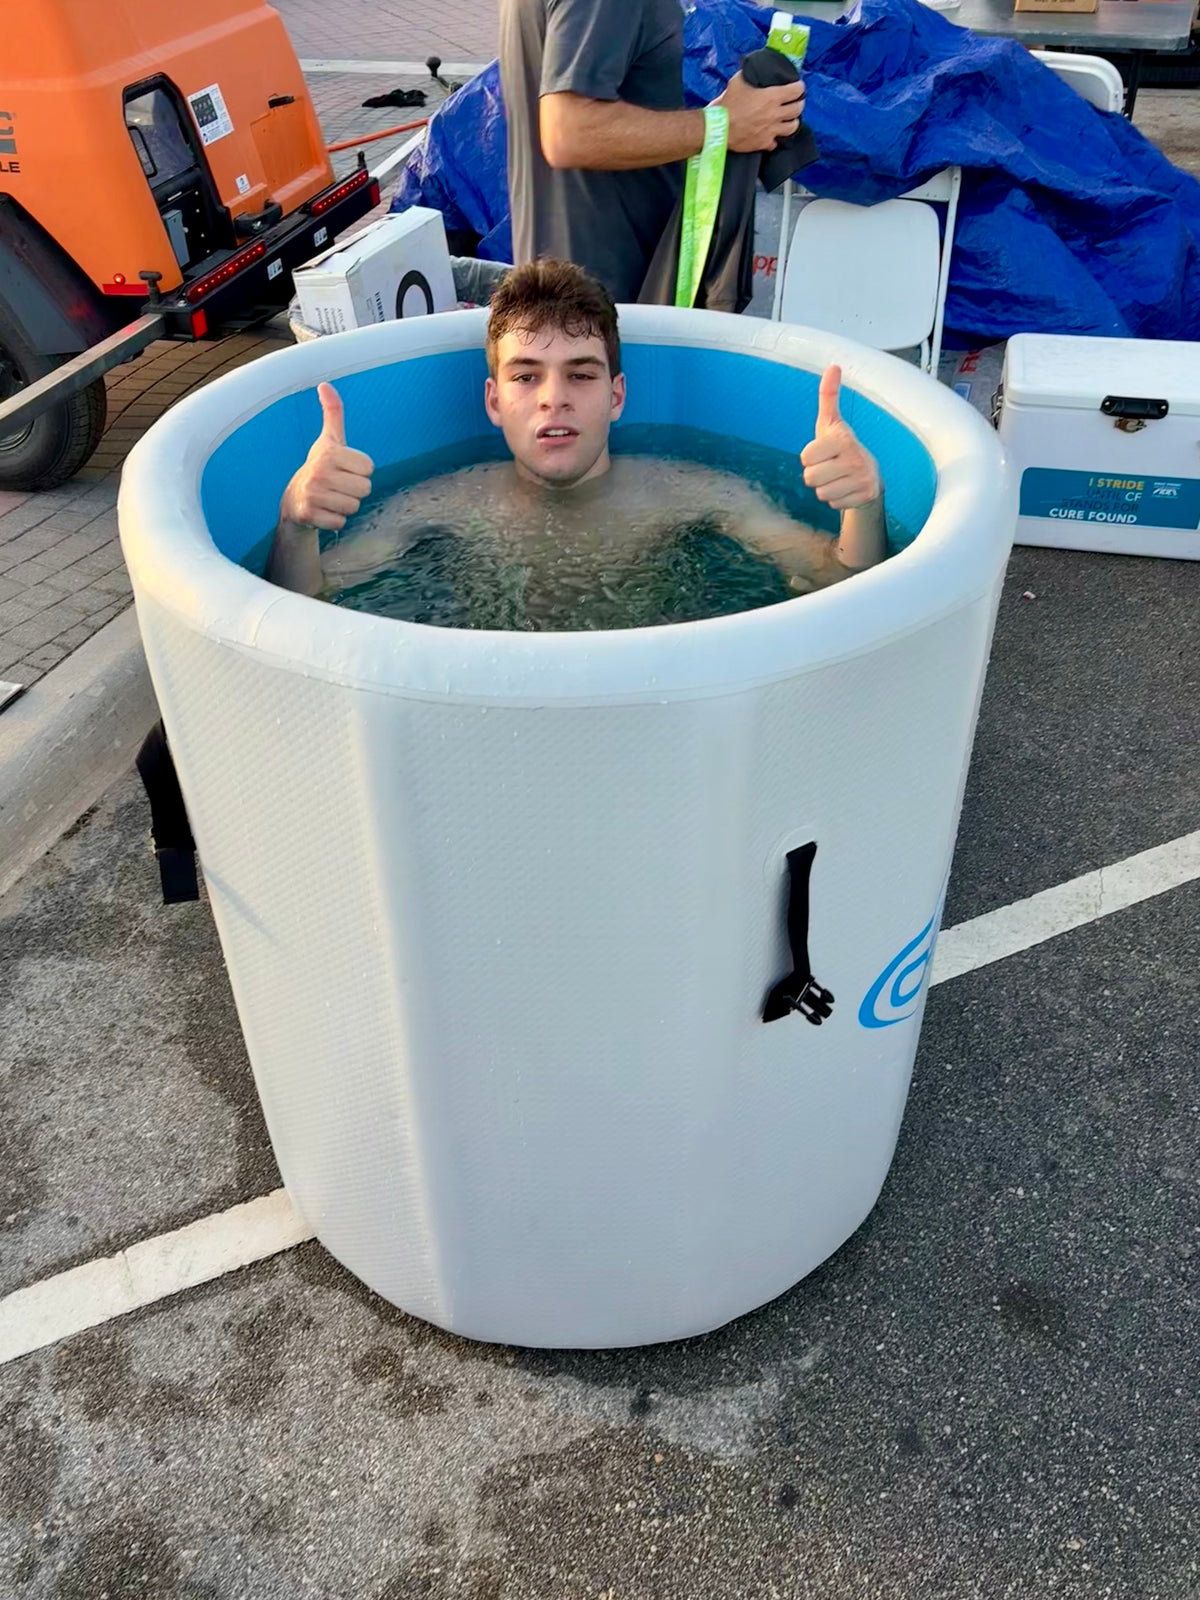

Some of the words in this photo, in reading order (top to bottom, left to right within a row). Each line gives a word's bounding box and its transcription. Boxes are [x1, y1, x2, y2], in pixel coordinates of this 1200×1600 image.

[1088, 477, 1094, 487] I
[1097, 478, 1145, 490] STRIDE
[1125, 491, 1143, 502] CF
[1062, 498, 1109, 512] STANDS
[1114, 501, 1139, 513] FOR
[1049, 507, 1085, 519] CURE
[1088, 511, 1138, 524] FOUND
